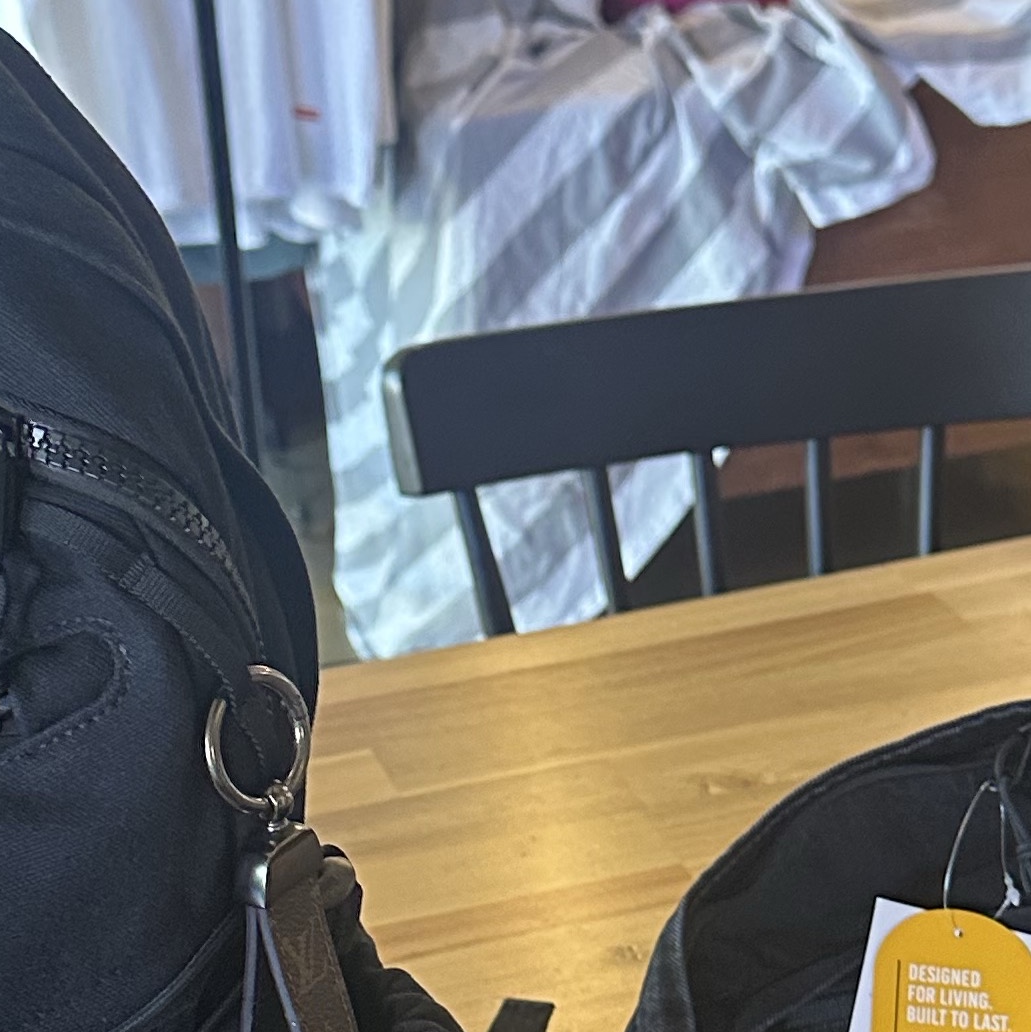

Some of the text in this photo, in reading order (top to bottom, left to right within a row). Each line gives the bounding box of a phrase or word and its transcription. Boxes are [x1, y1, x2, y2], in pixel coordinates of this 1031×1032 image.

[908, 963, 981, 987] DESIGNED
[907, 984, 993, 1010] FOR LIVING.
[906, 1005, 947, 1026] BUILT
[951, 1010, 969, 1029] TO
